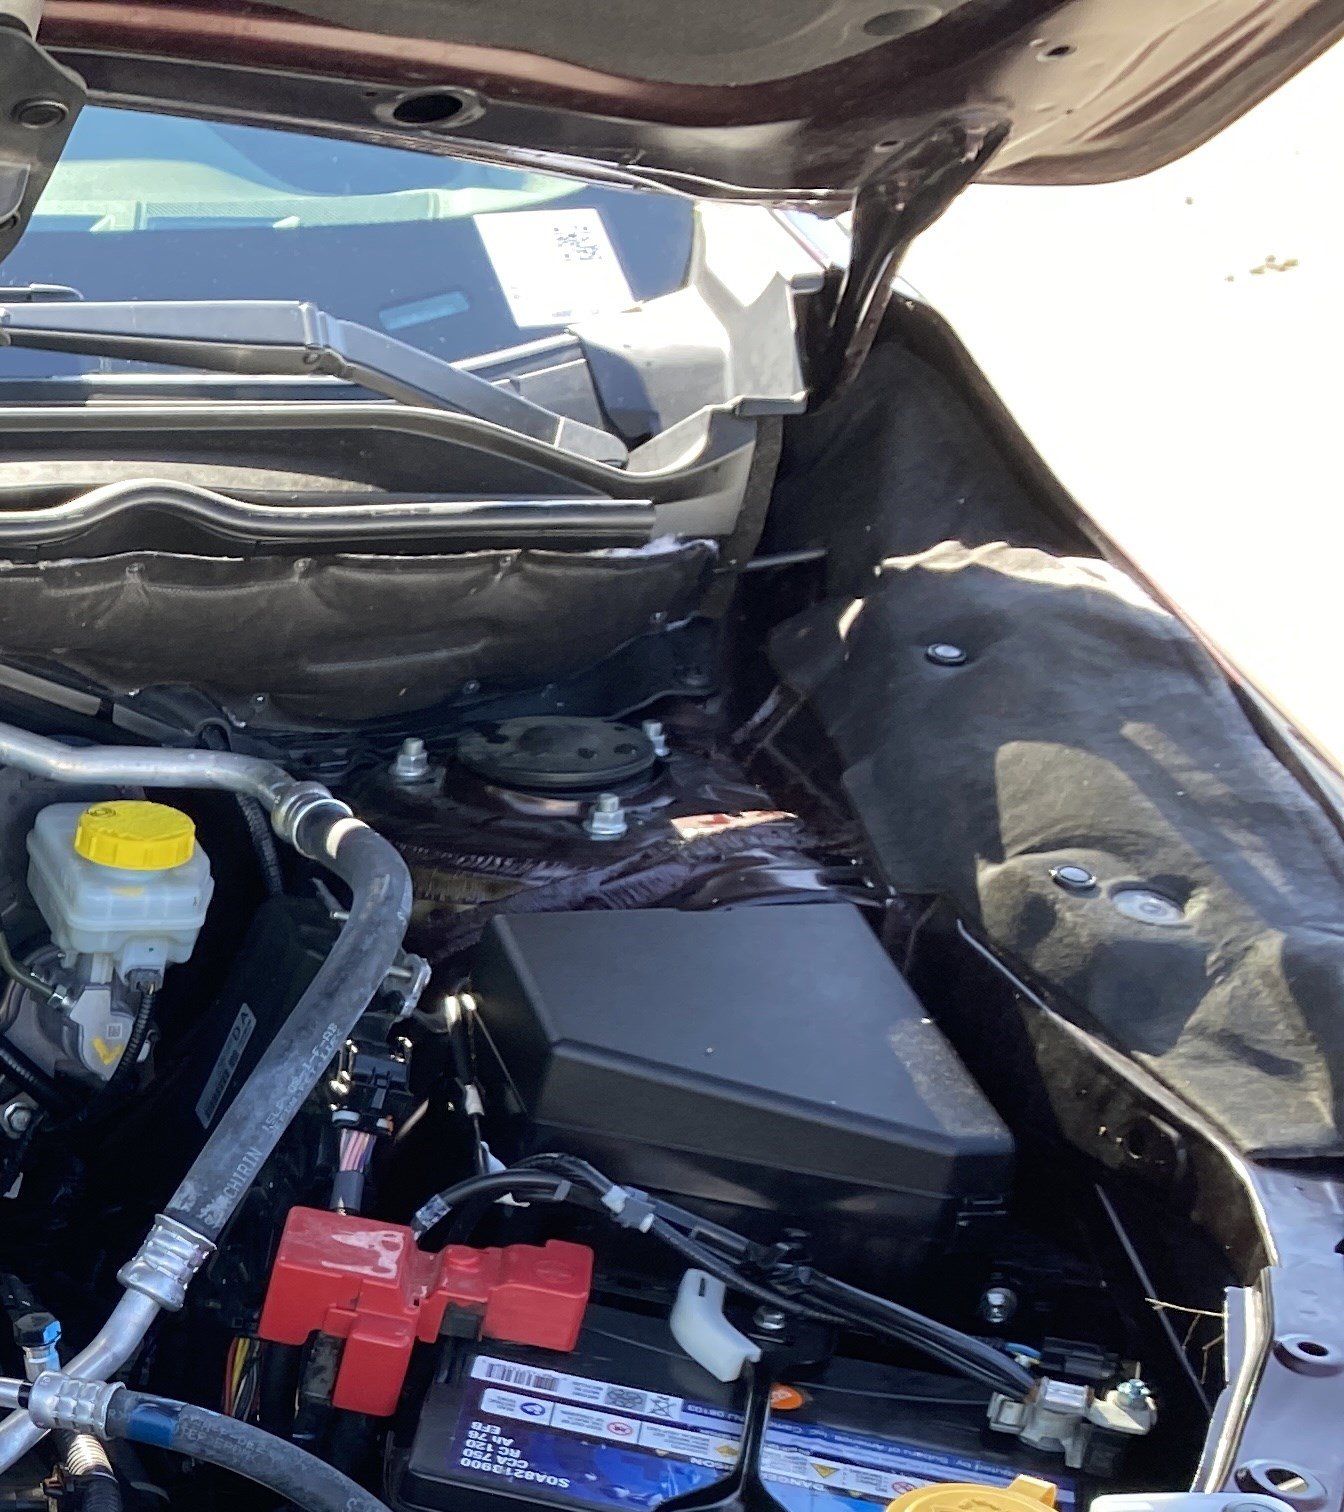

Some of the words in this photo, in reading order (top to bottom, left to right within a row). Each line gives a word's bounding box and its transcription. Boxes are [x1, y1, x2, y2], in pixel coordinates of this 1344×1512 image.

[471, 1421, 501, 1435] EFB
[465, 1439, 494, 1452] 120
[492, 1435, 514, 1447] Ah
[462, 1448, 492, 1462] 750
[498, 1446, 521, 1458] RC
[496, 1455, 529, 1469] CCA
